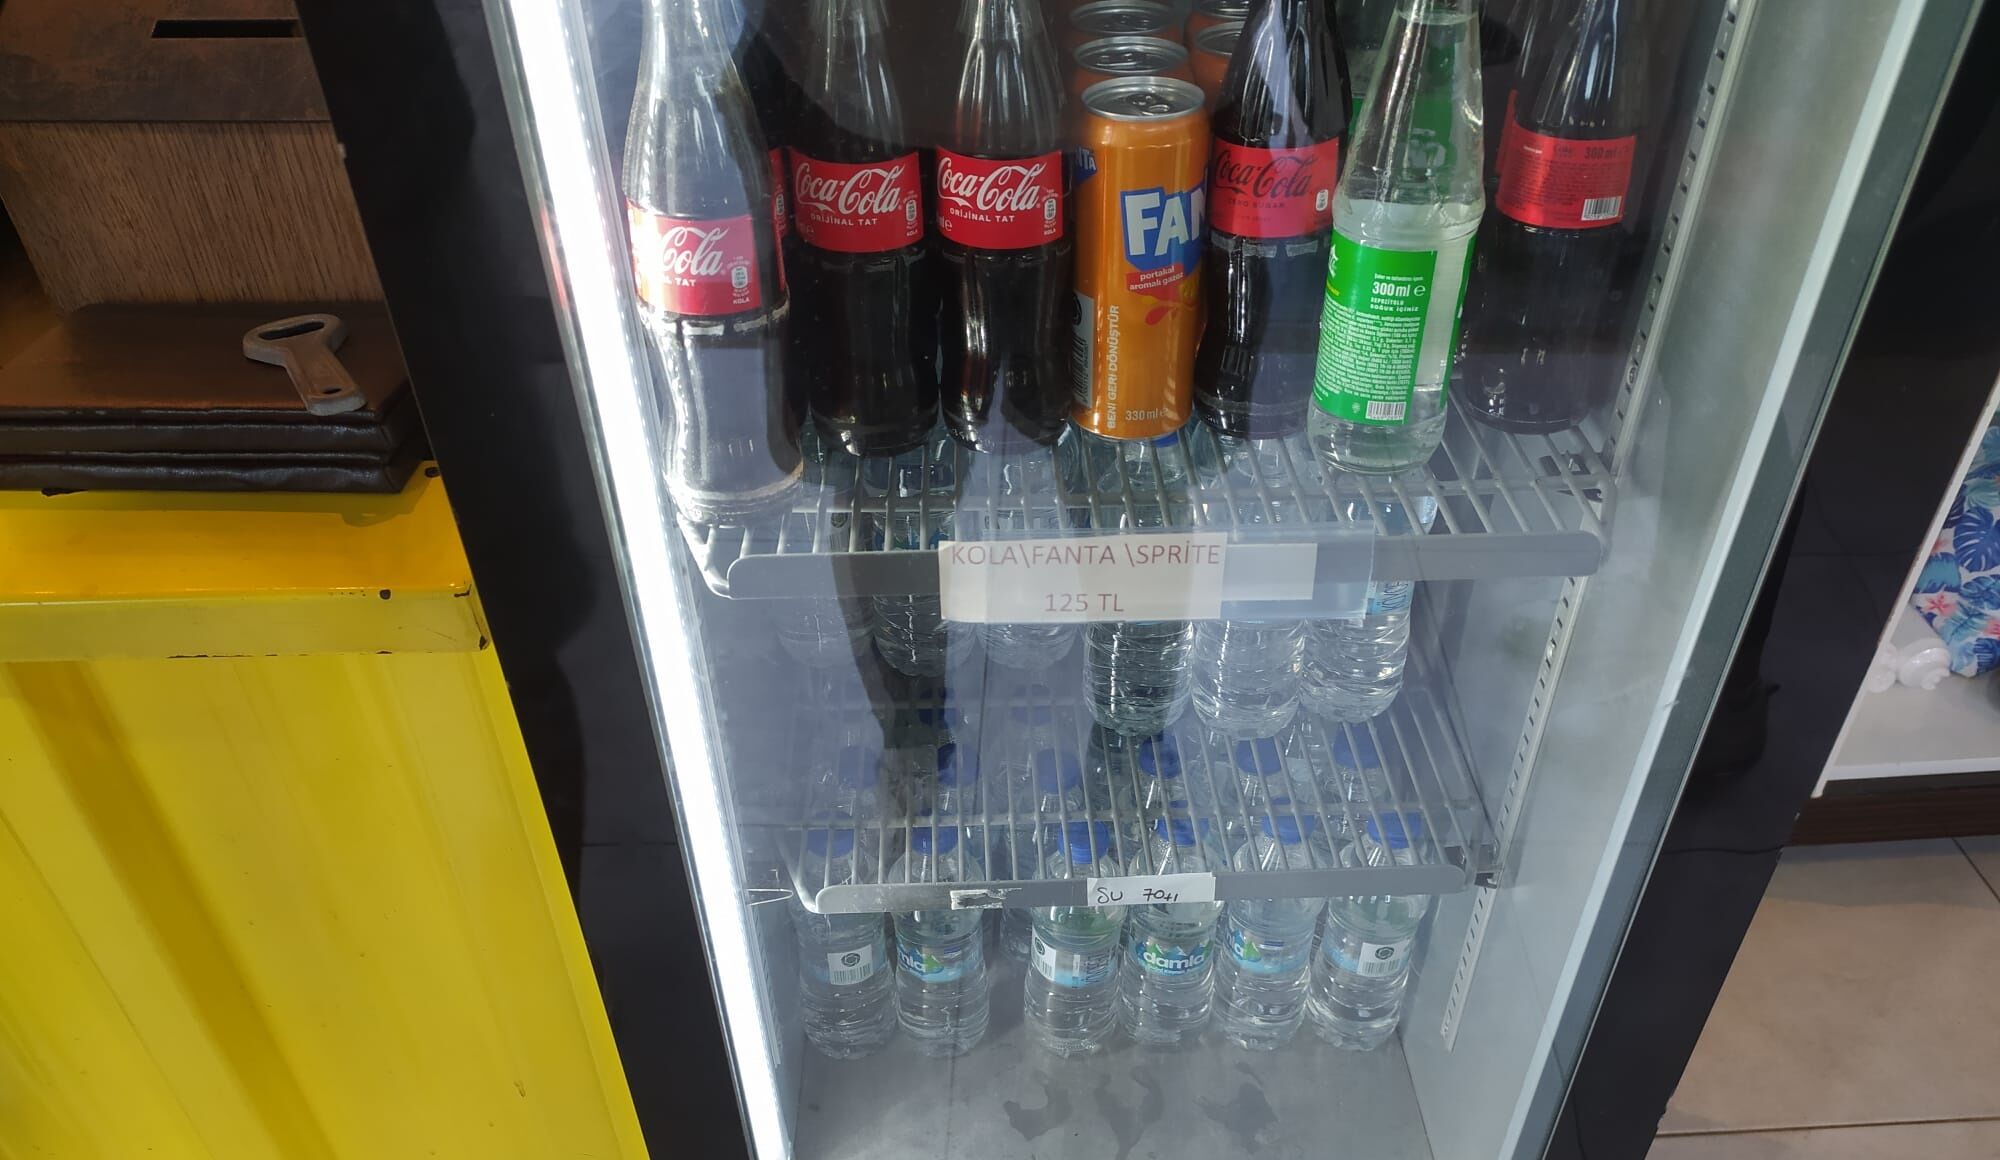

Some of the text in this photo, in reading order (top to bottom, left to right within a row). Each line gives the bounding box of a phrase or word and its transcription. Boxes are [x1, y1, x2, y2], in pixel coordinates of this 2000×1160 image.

[1216, 150, 1318, 199] Coca-Cola
[796, 163, 905, 215] Coca-Cola
[937, 157, 1047, 212] Coca-Cola
[858, 218, 878, 226] TAT
[995, 215, 1015, 223] TAT
[674, 277, 697, 287] TAT
[1140, 265, 1175, 282] portakal
[1372, 281, 1395, 297] 300
[1395, 284, 1411, 297] ml
[1125, 409, 1145, 421] 330
[1146, 407, 1158, 420] ml
[1045, 593, 1125, 612] 125 TL
[1096, 886, 1123, 904] SU
